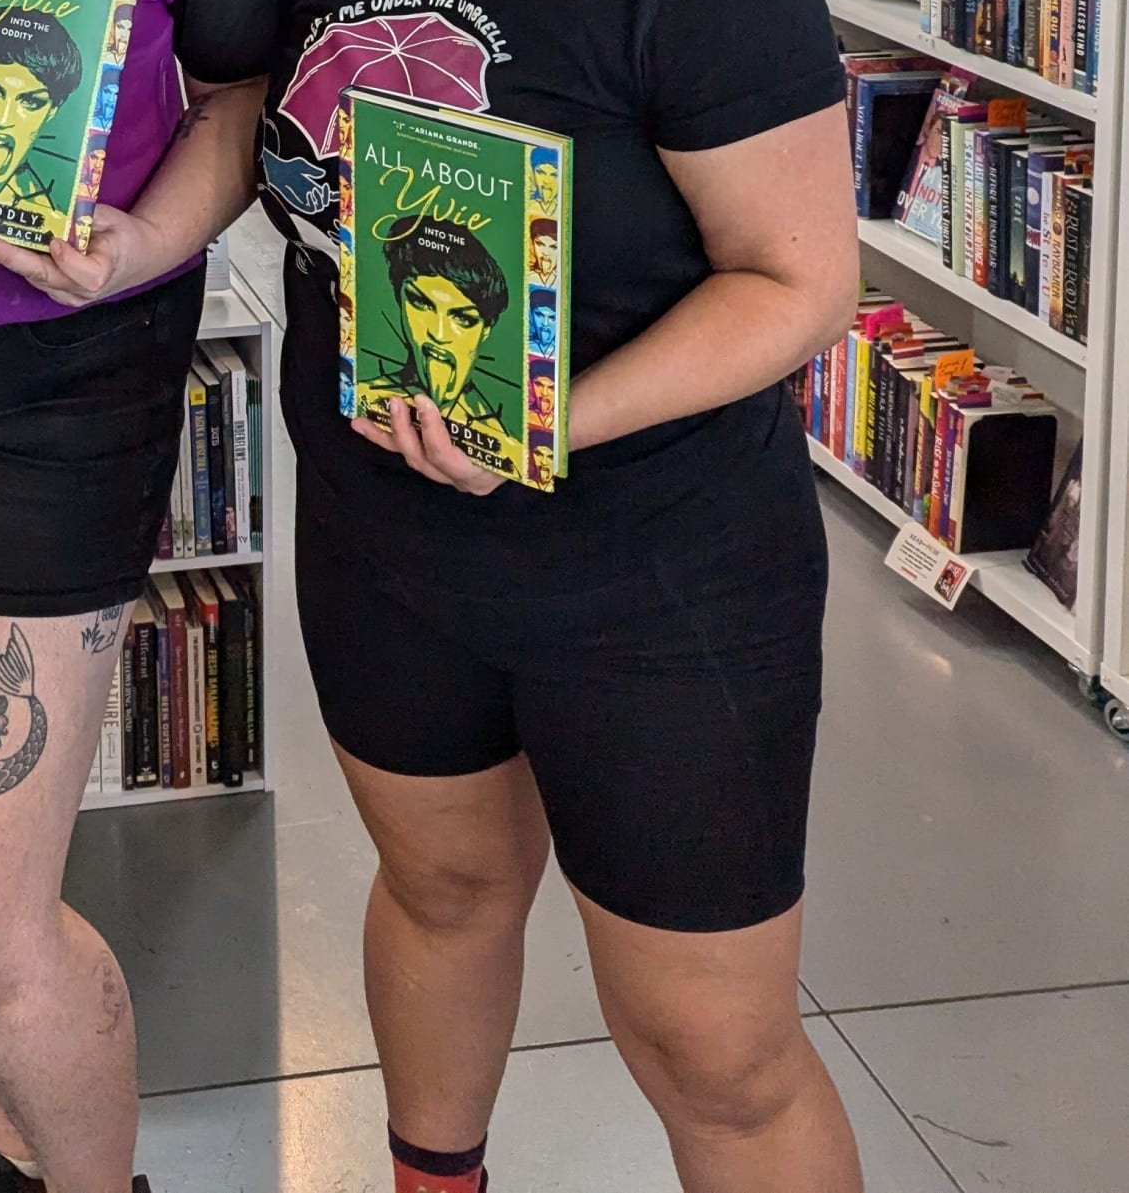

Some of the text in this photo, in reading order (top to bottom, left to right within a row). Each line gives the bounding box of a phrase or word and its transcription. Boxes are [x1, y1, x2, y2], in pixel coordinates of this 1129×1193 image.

[339, 2, 365, 21] ME
[1, 27, 33, 41] ODDITY
[10, 17, 50, 33] INTO THE
[1077, 32, 1086, 56] KIND
[941, 136, 949, 160] DARK
[365, 143, 514, 201] ALL ABOUT
[372, 166, 492, 241] Yvie
[965, 144, 973, 265] SOCIAL INTERCOURSE
[7, 227, 42, 242] BACH
[418, 237, 451, 254] ODDITY
[424, 227, 465, 246] INTO THE
[1052, 240, 1061, 299] RAYBEARER
[867, 390, 876, 425] MILLION
[195, 410, 205, 437] VAGINA
[449, 423, 495, 449] DDLY
[234, 420, 245, 461] UNDERFLOWS
[866, 438, 874, 459] ONE
[468, 446, 503, 468] BACH
[140, 629, 149, 678] Different
[209, 650, 217, 676] FRESH
